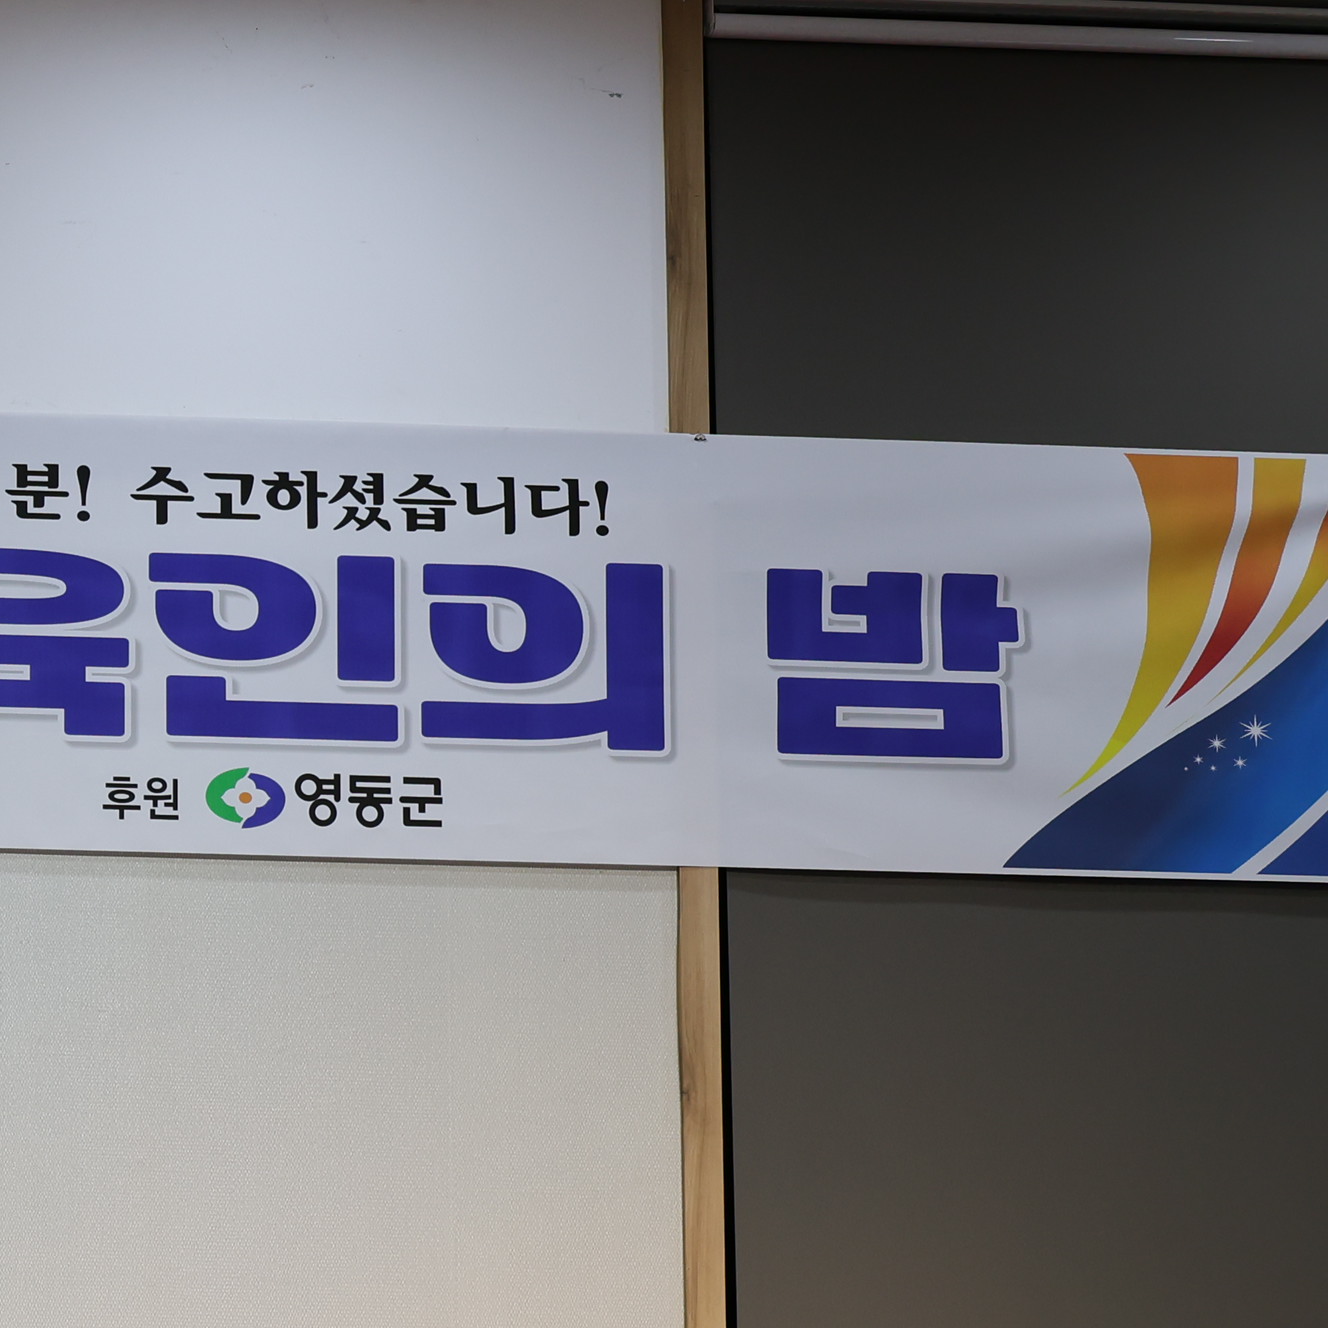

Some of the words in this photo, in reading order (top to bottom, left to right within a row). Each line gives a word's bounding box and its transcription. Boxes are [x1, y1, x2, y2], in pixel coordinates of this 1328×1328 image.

[130, 466, 610, 537] 수고하셨습니다!
[766, 567, 1021, 759] 밤
[102, 776, 179, 821] 후원
[294, 773, 443, 829] 영동군
